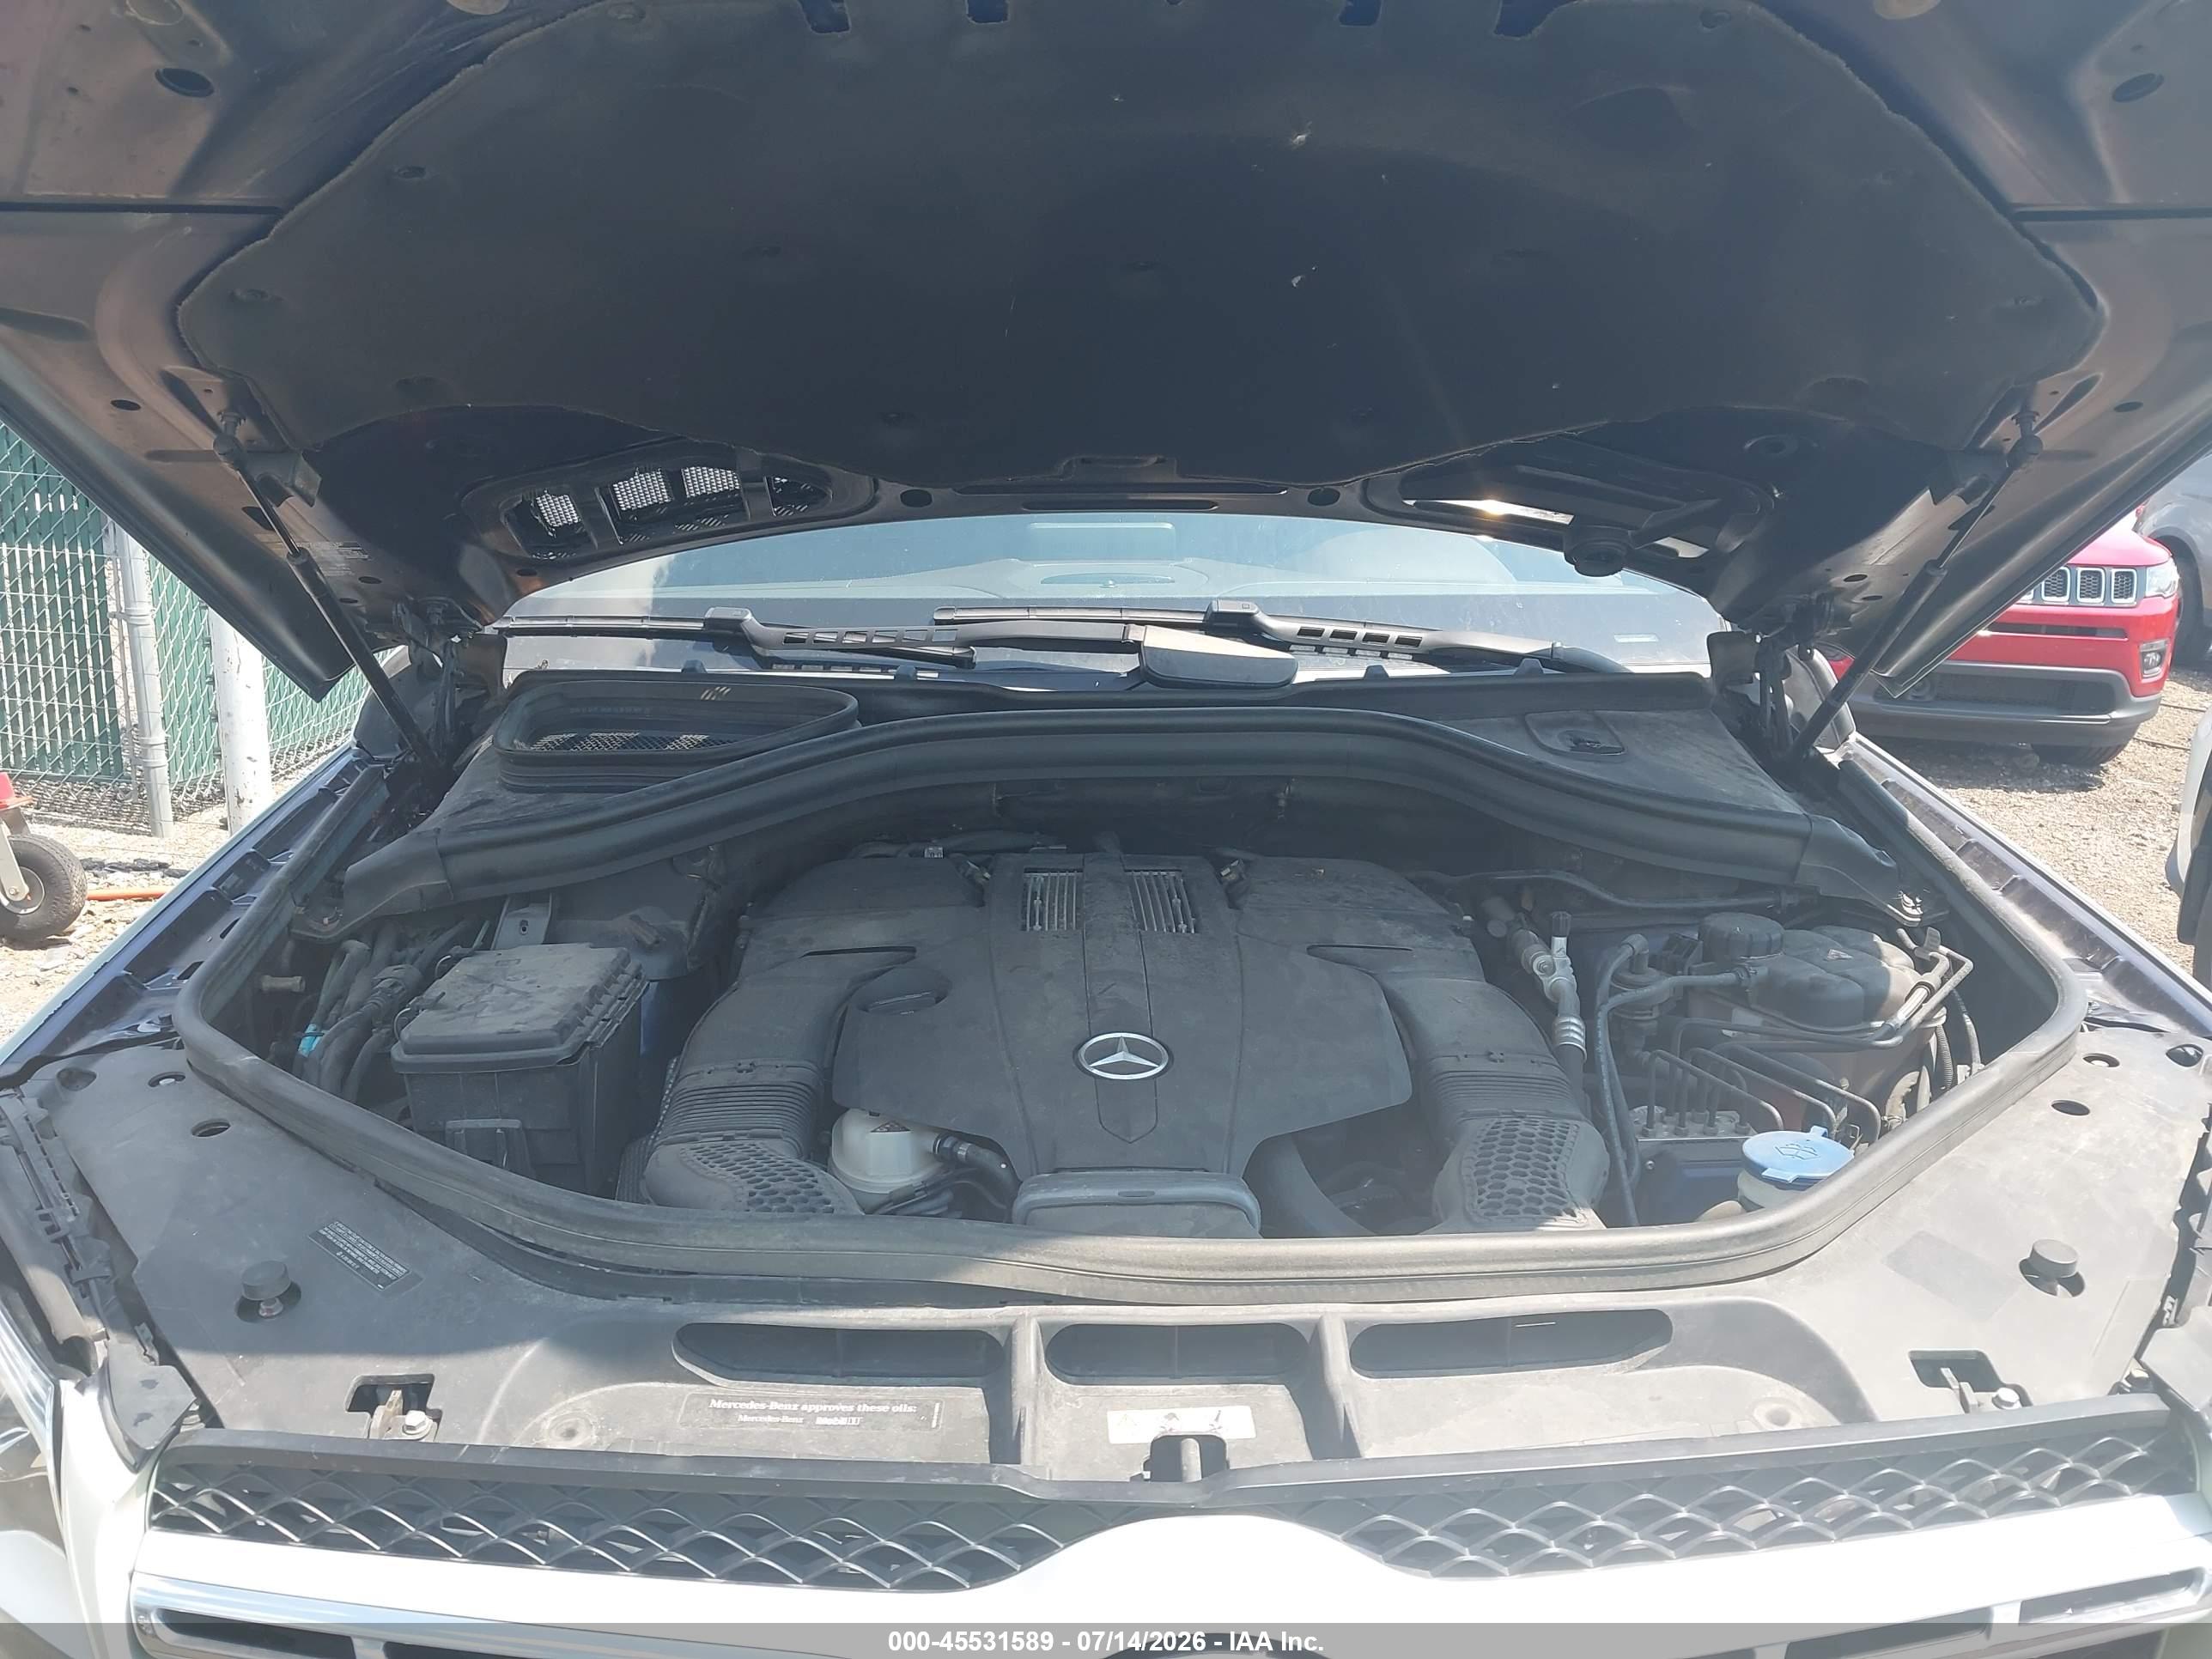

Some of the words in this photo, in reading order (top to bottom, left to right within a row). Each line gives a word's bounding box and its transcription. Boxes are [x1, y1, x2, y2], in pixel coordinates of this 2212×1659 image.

[708, 1398, 799, 1411] Mercedes-Benz
[801, 1402, 854, 1413] approves
[857, 1403, 890, 1413] these
[891, 1403, 917, 1413] oils:
